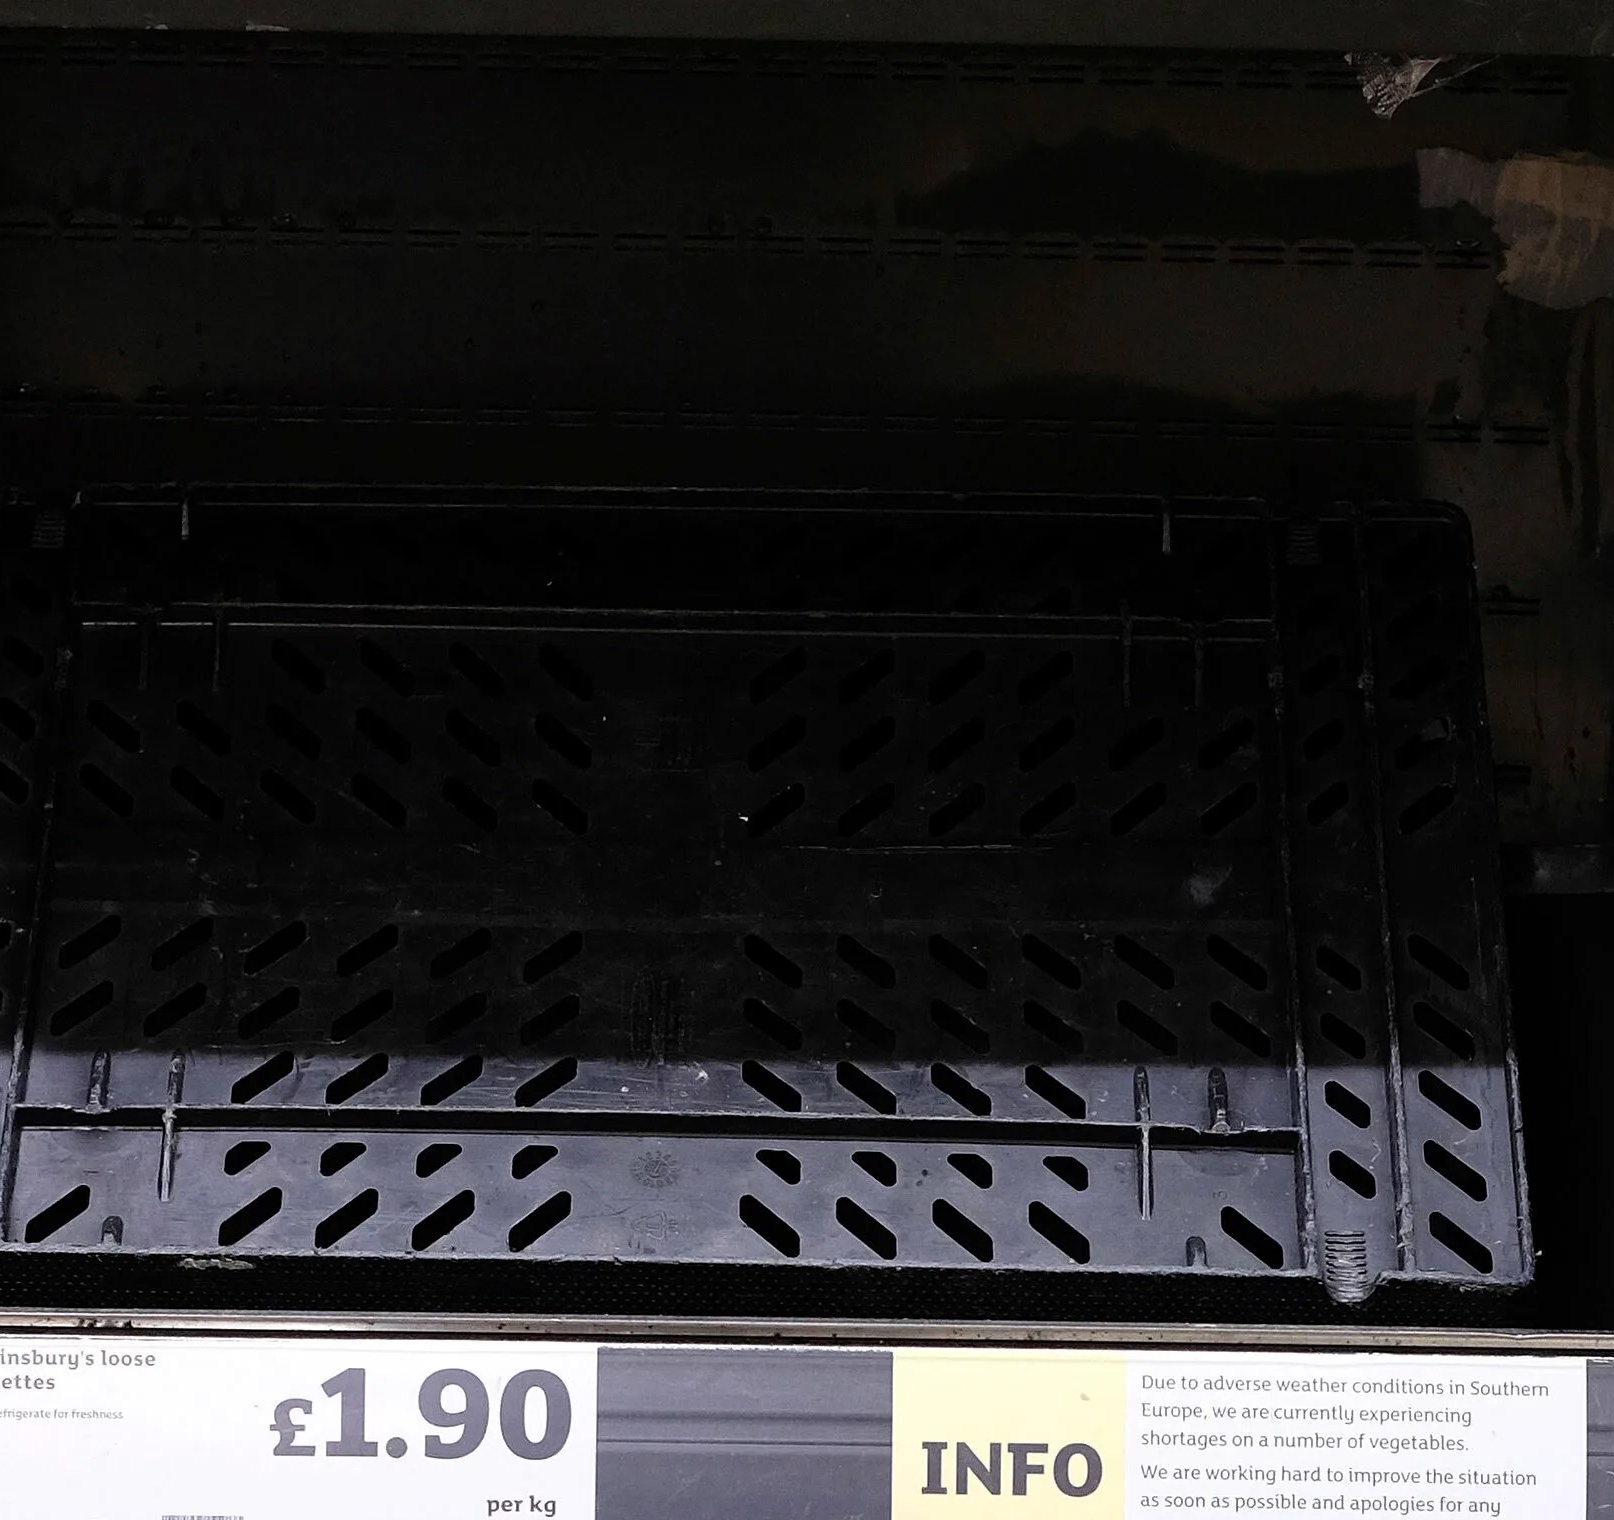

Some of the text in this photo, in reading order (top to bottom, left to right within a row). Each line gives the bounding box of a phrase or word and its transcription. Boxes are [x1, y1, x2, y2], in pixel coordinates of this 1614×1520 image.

[102, 1350, 156, 1366] loose
[1142, 1375, 1549, 1397] Due to adverse weather conditions in Southern
[53, 1408, 69, 1419] for
[71, 1409, 124, 1419] freshness
[269, 1367, 572, 1461] £1.90
[1142, 1403, 1472, 1427] Europe, we are currently experiencing
[1141, 1432, 1469, 1453] shortages on a number of vegetables.
[921, 1441, 1103, 1498] INFO
[1141, 1465, 1537, 1487] We are working hard to improve the situation
[487, 1495, 557, 1518] per kg
[1141, 1494, 1501, 1518] as soon as possible and apologies for any
